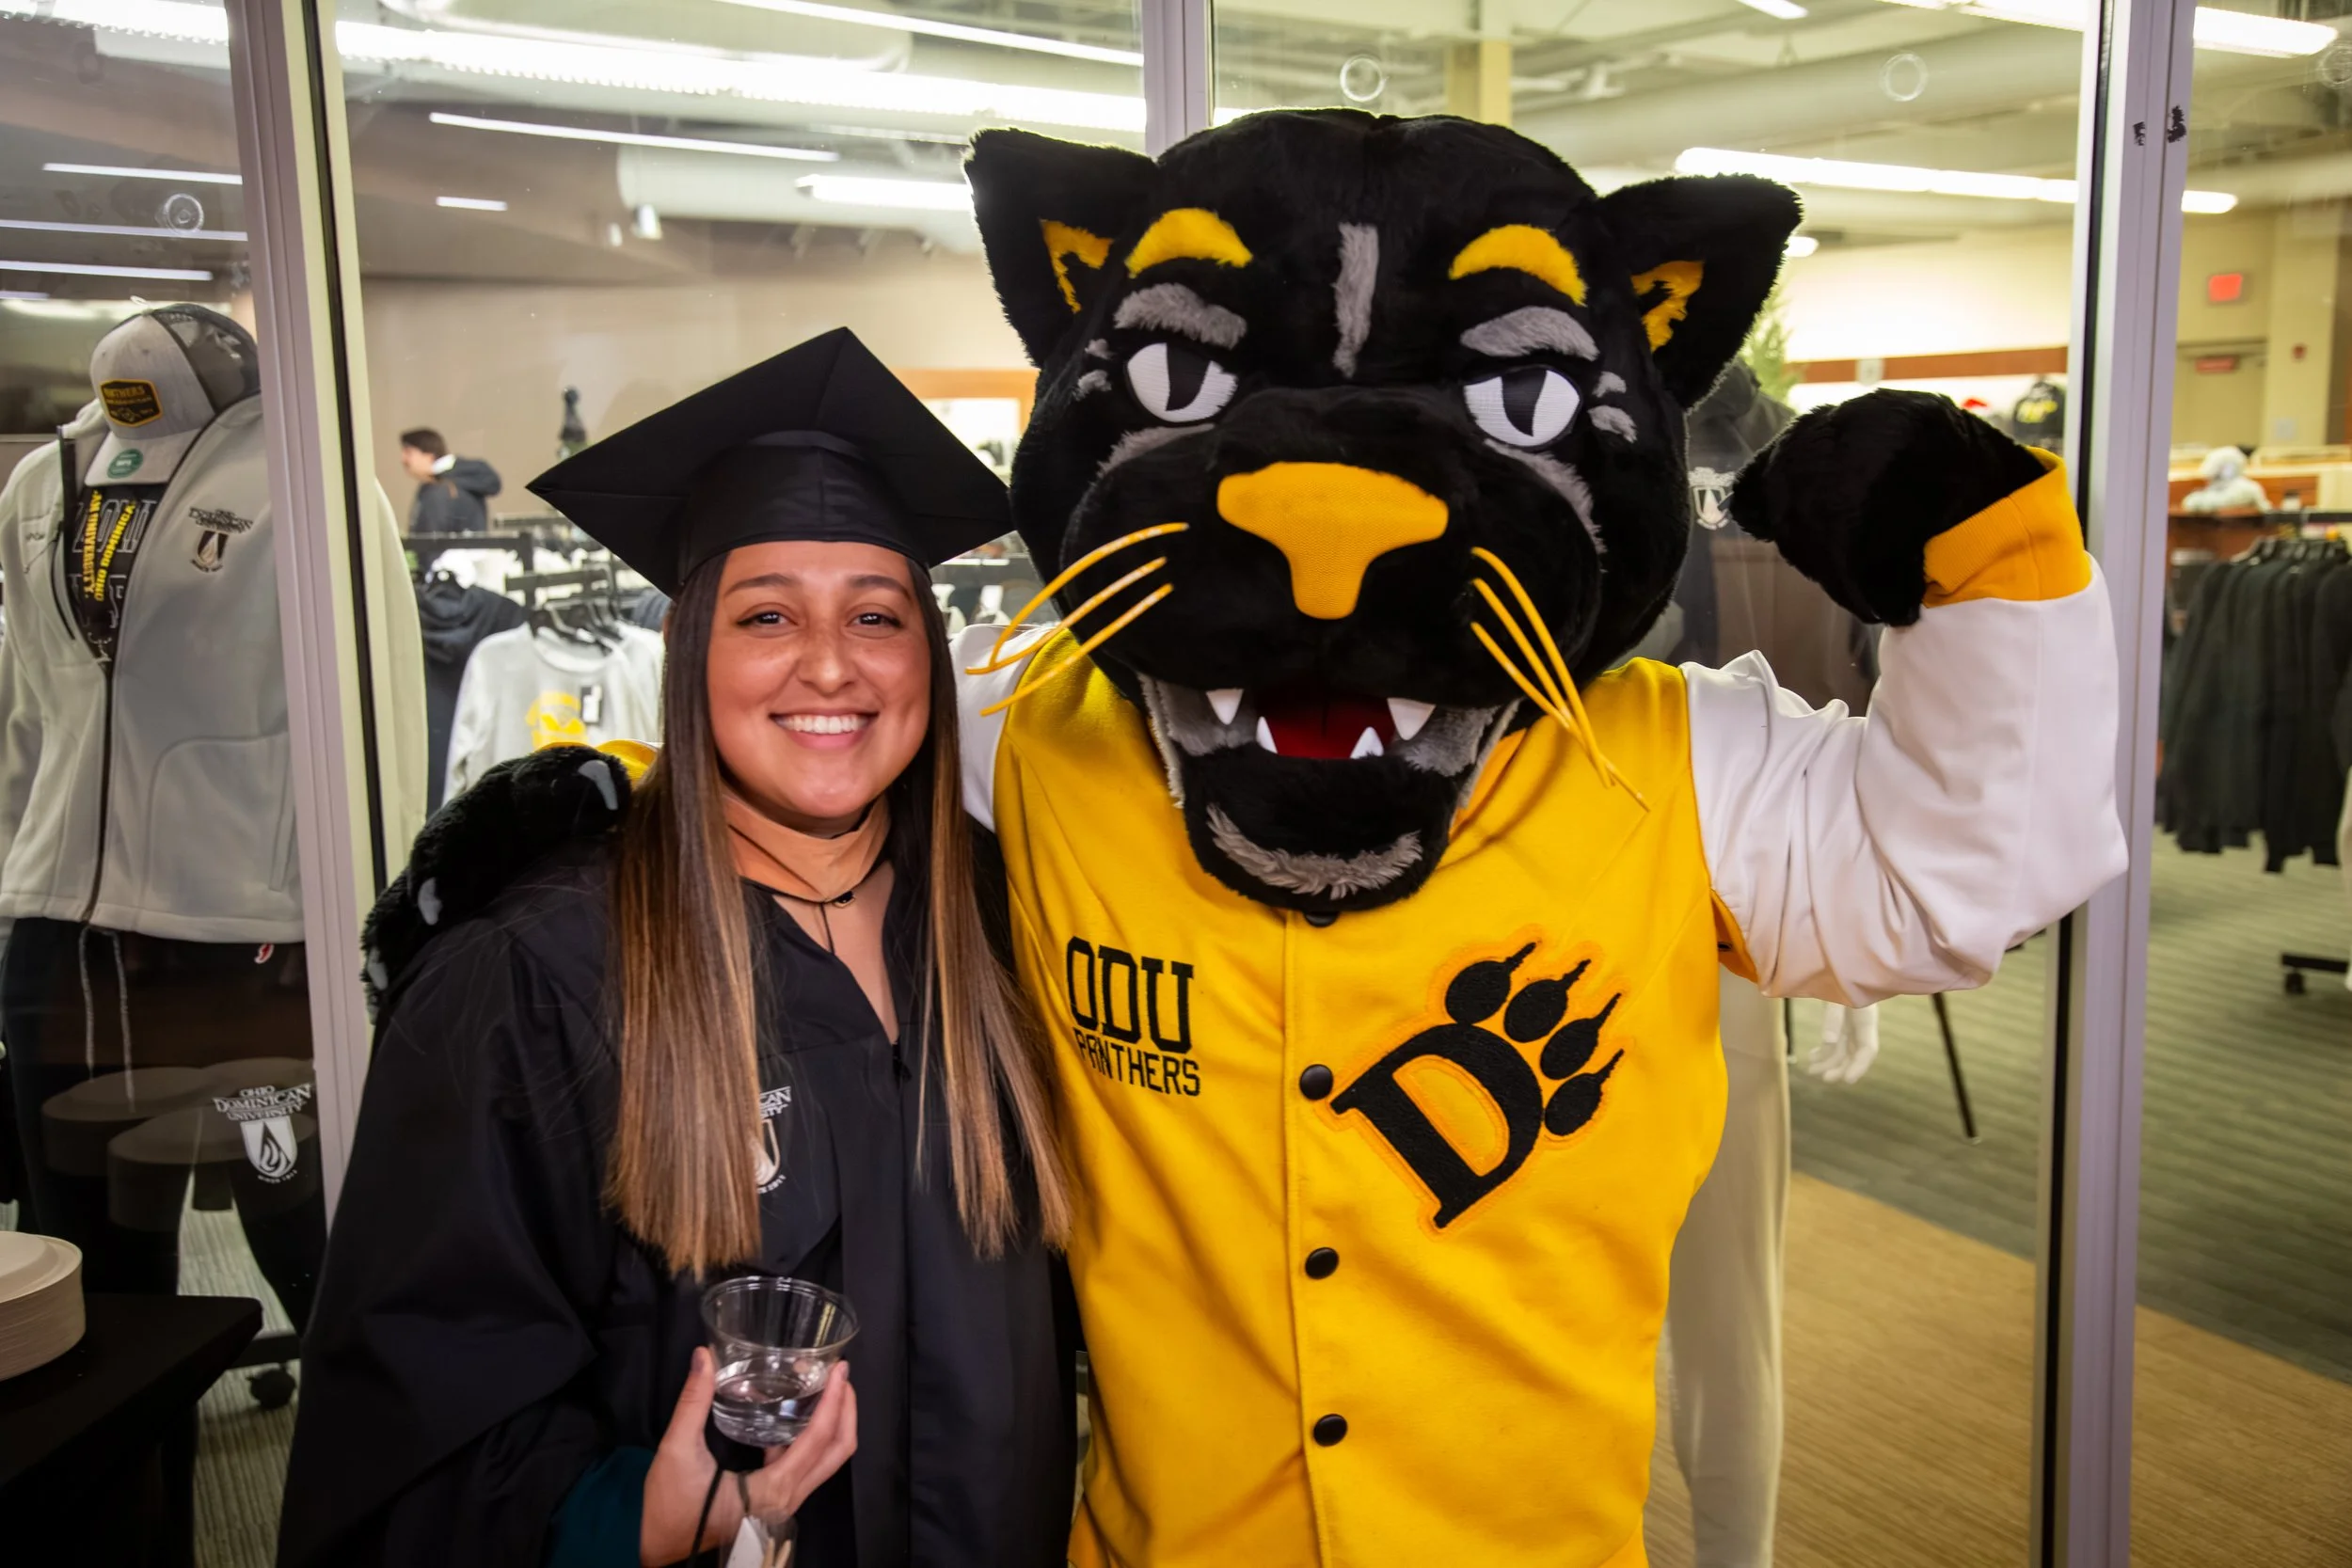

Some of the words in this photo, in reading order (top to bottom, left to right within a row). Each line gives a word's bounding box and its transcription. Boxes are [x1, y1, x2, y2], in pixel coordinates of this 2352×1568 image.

[95, 569, 107, 601] OHIO
[1067, 936, 1194, 1054] ODU
[1073, 1026, 1200, 1097] PANTHERS
[213, 1083, 312, 1113] DOMINICAN
[239, 1085, 276, 1098] OHIO
